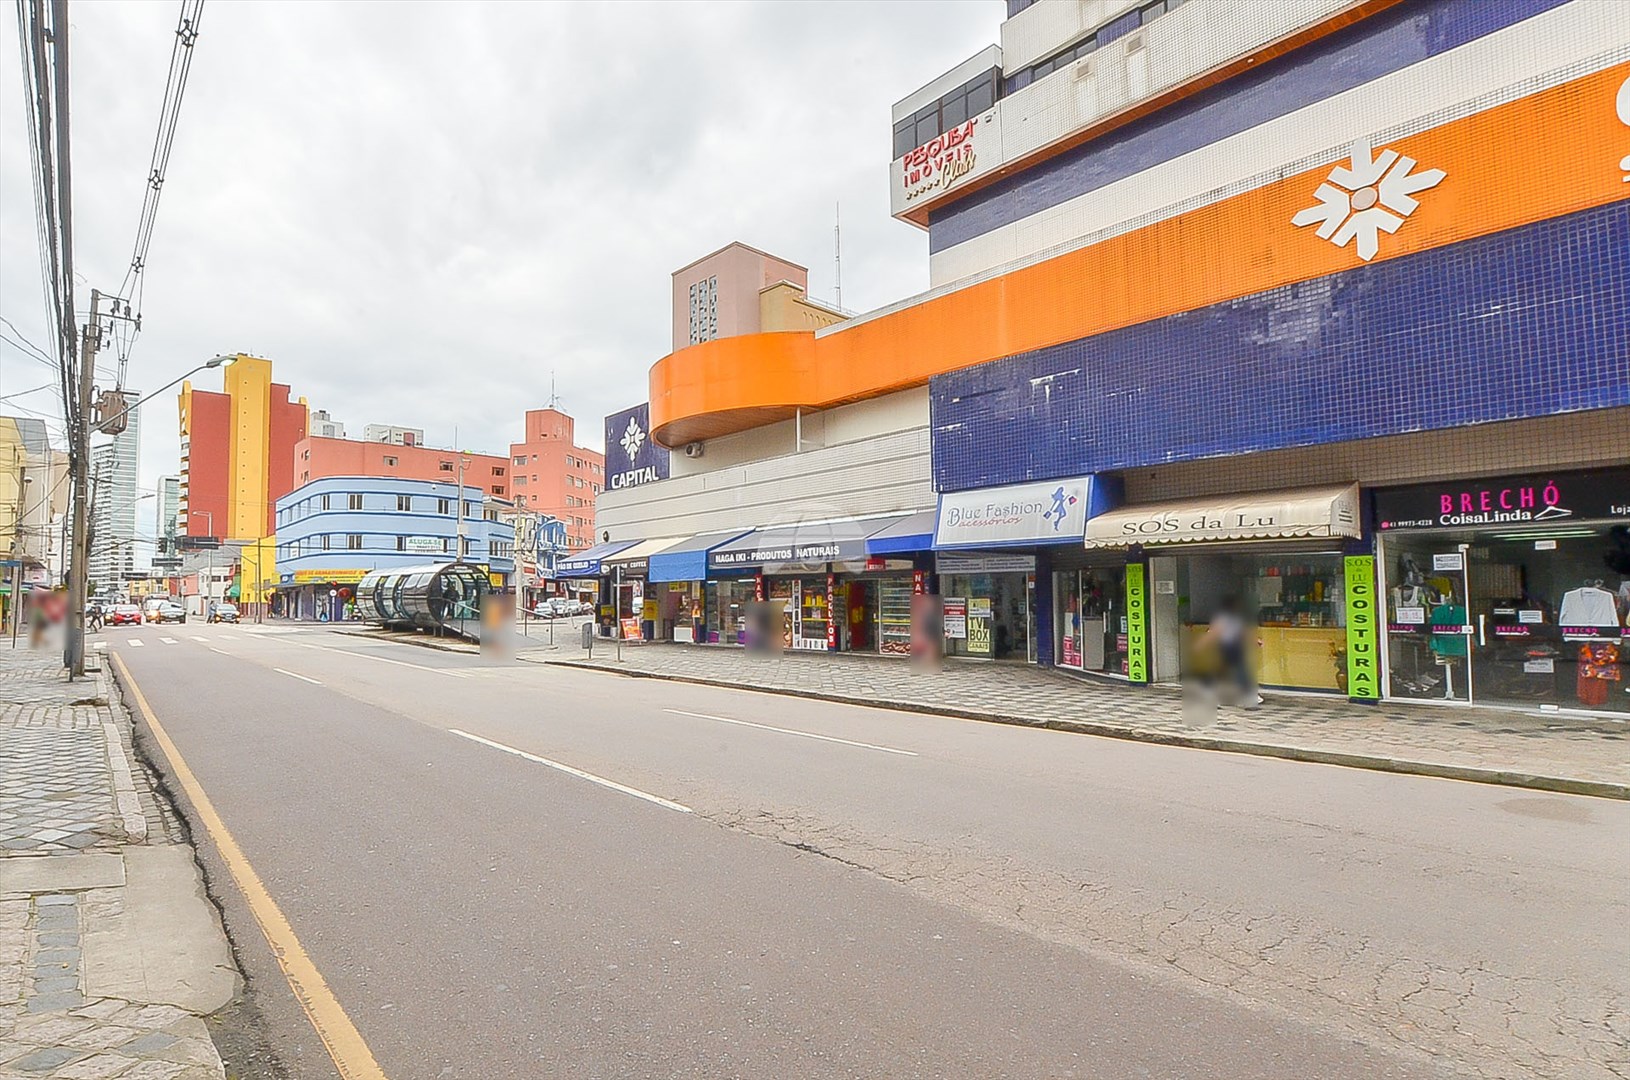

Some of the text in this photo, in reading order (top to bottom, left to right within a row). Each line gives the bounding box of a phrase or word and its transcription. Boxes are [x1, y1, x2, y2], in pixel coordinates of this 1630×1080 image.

[903, 120, 974, 171] PESQUISA
[611, 465, 659, 489] CAPITAL
[1440, 480, 1560, 514] BRECHÓ
[946, 502, 1043, 527] Blue Fashion
[958, 516, 1023, 528] acessórios
[1122, 514, 1275, 535] SOS da Lu
[1439, 509, 1533, 526] CoisaLinda
[408, 538, 442, 546] ALUGA-SE
[715, 554, 735, 563] NAGA
[751, 549, 792, 561] PRODUTOS
[796, 545, 840, 558] NATURAIS
[969, 617, 984, 629] TV
[969, 629, 989, 641] BOX
[1130, 588, 1142, 680] COSTURAS
[1351, 585, 1371, 697] COSTURAS
